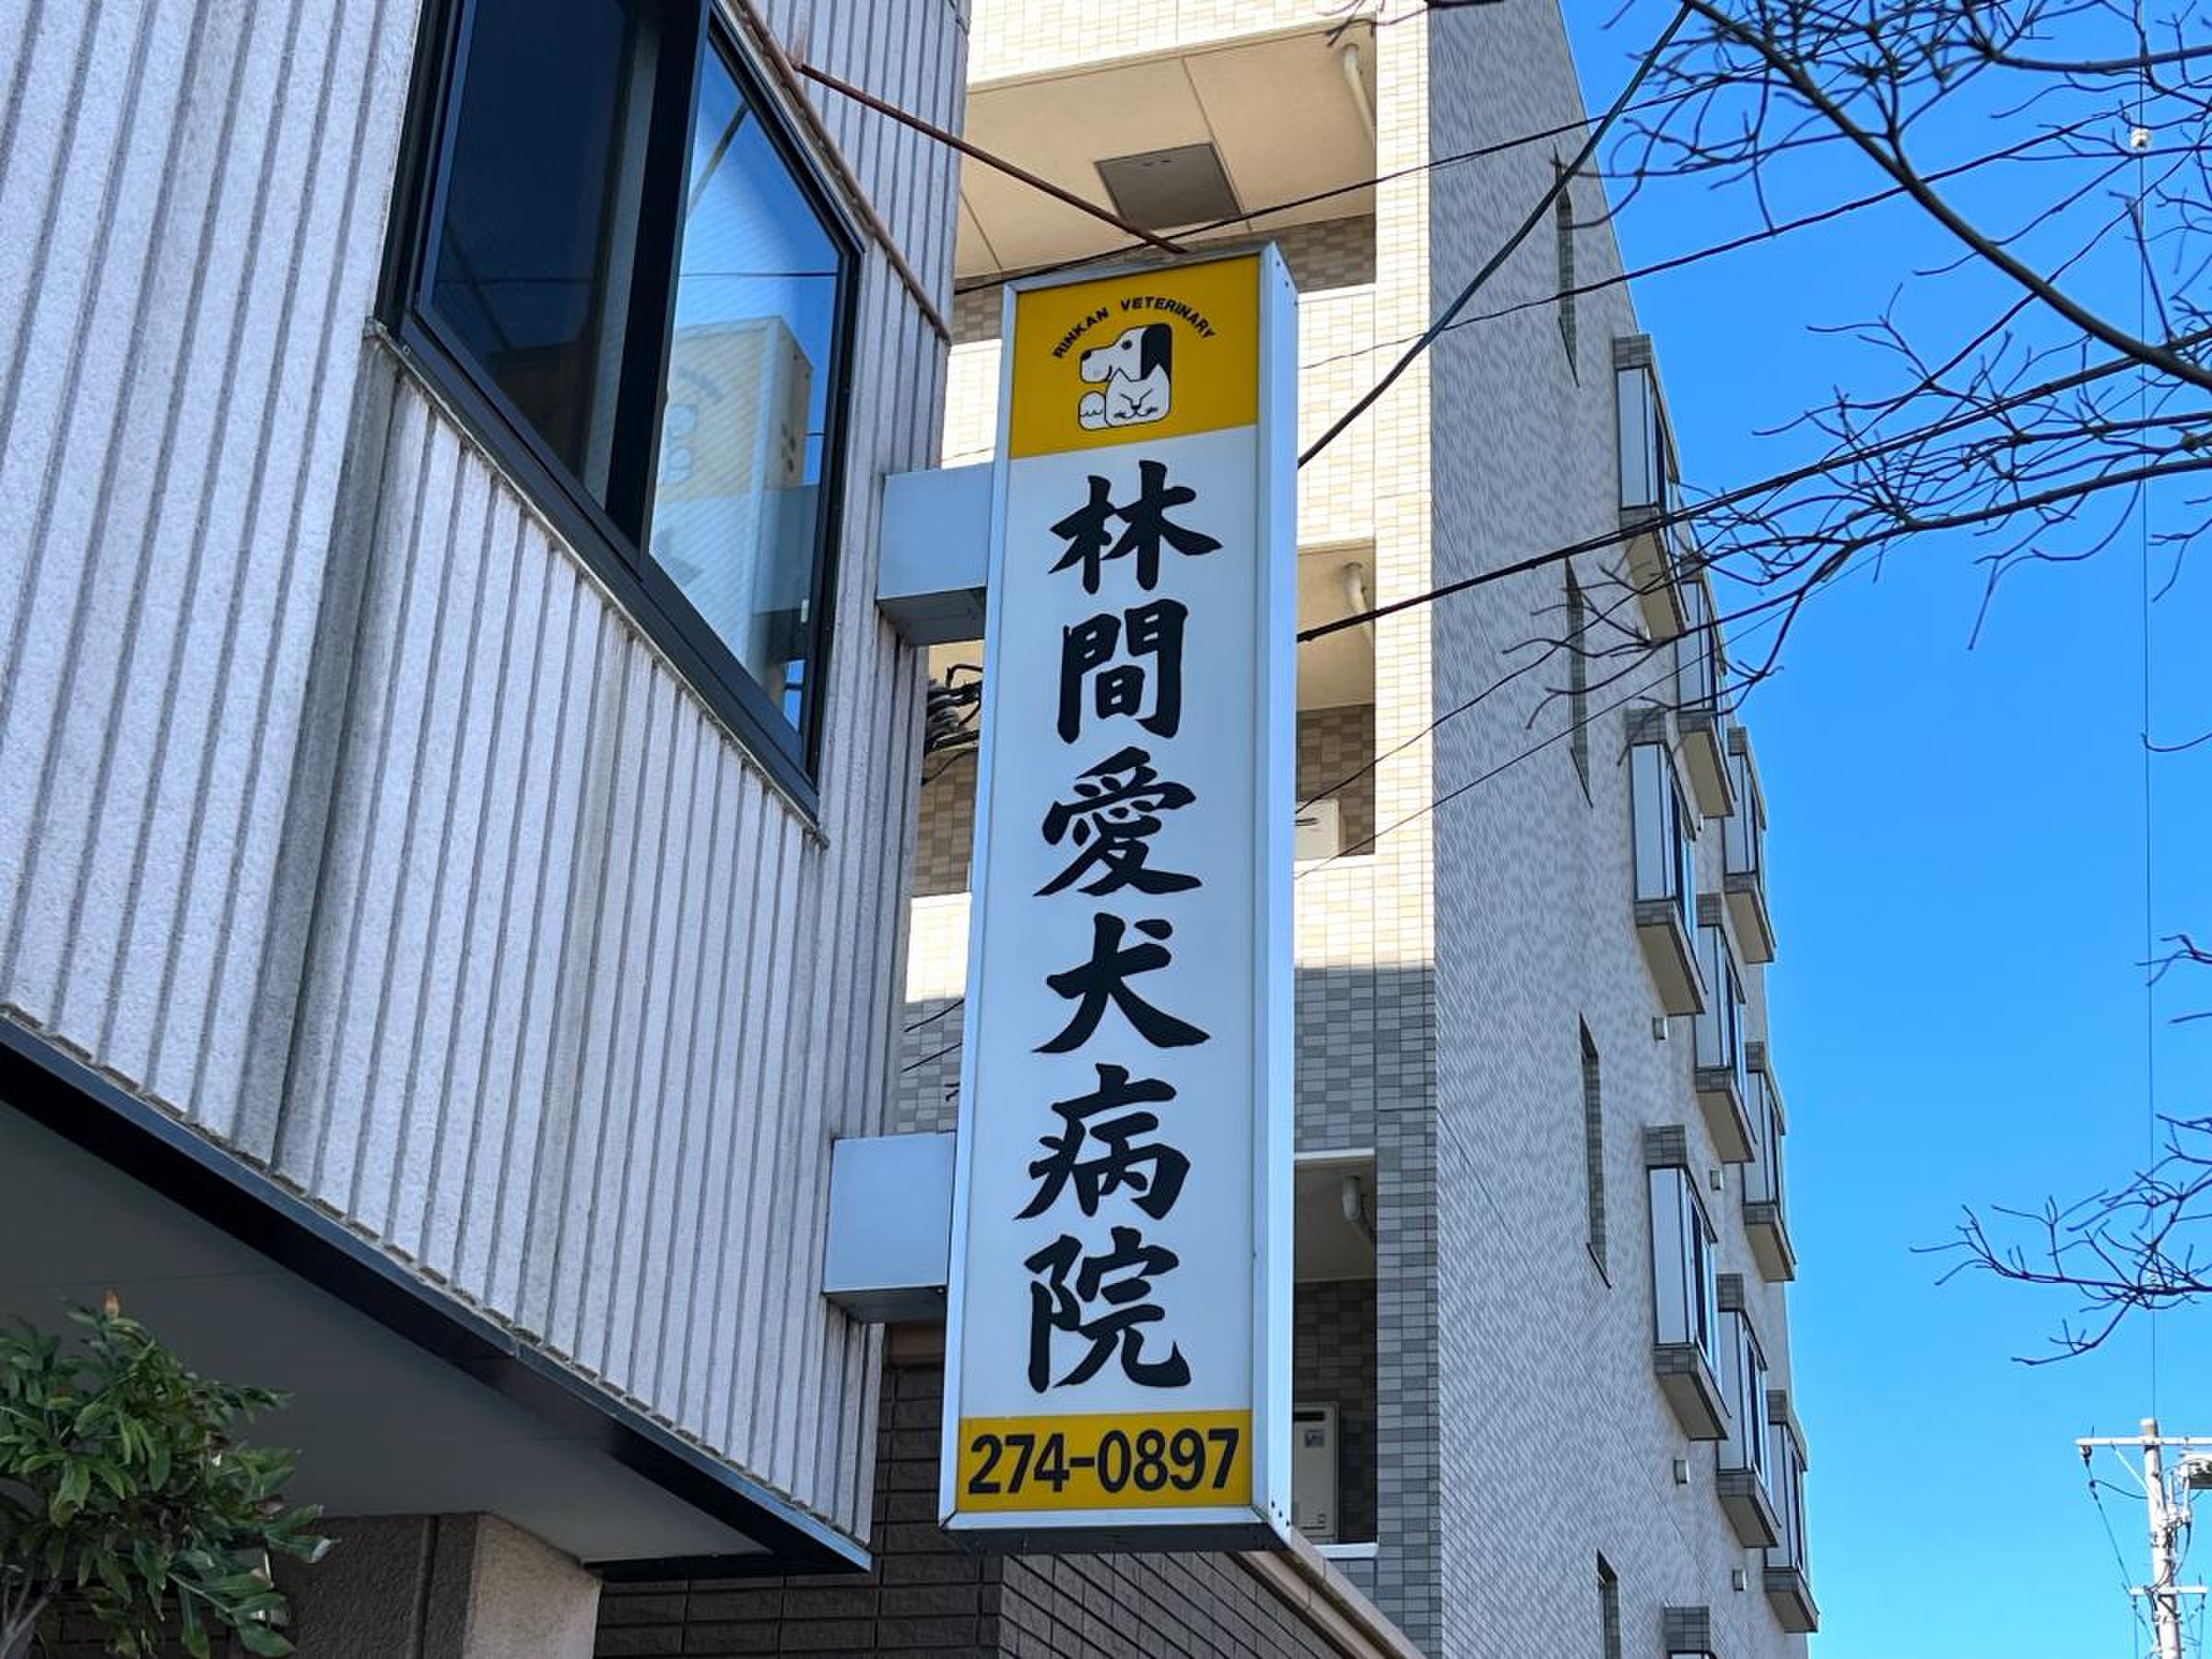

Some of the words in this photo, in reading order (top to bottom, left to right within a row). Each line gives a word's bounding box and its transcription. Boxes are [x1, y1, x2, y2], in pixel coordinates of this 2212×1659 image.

[1053, 307, 1109, 359] RINKAN
[1121, 296, 1216, 339] VETERINARY
[1015, 460, 1222, 1394] 林間愛犬病院
[968, 1428, 1240, 1495] 274-0897
